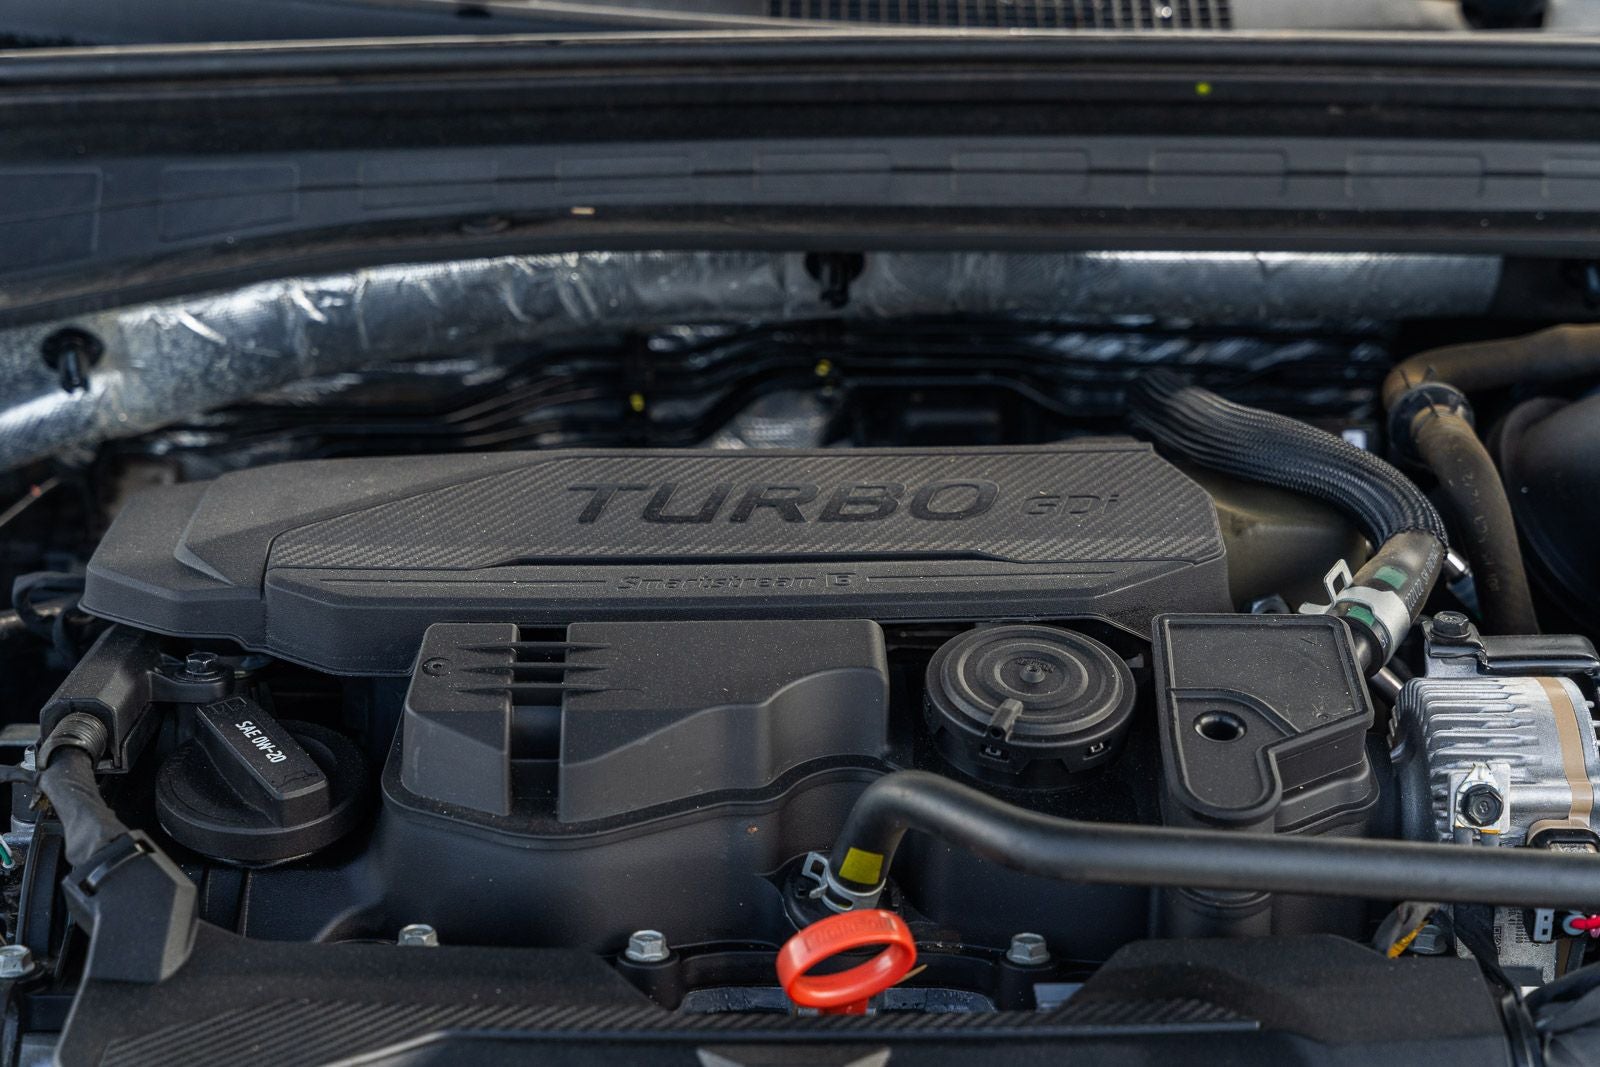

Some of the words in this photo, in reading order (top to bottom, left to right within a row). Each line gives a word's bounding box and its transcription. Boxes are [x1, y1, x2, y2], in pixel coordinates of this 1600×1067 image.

[567, 479, 1001, 524] TURBO
[1018, 494, 1119, 516] GDi
[616, 575, 817, 590] Smartstream
[235, 720, 262, 738] SAE
[251, 736, 287, 763] 0W-20
